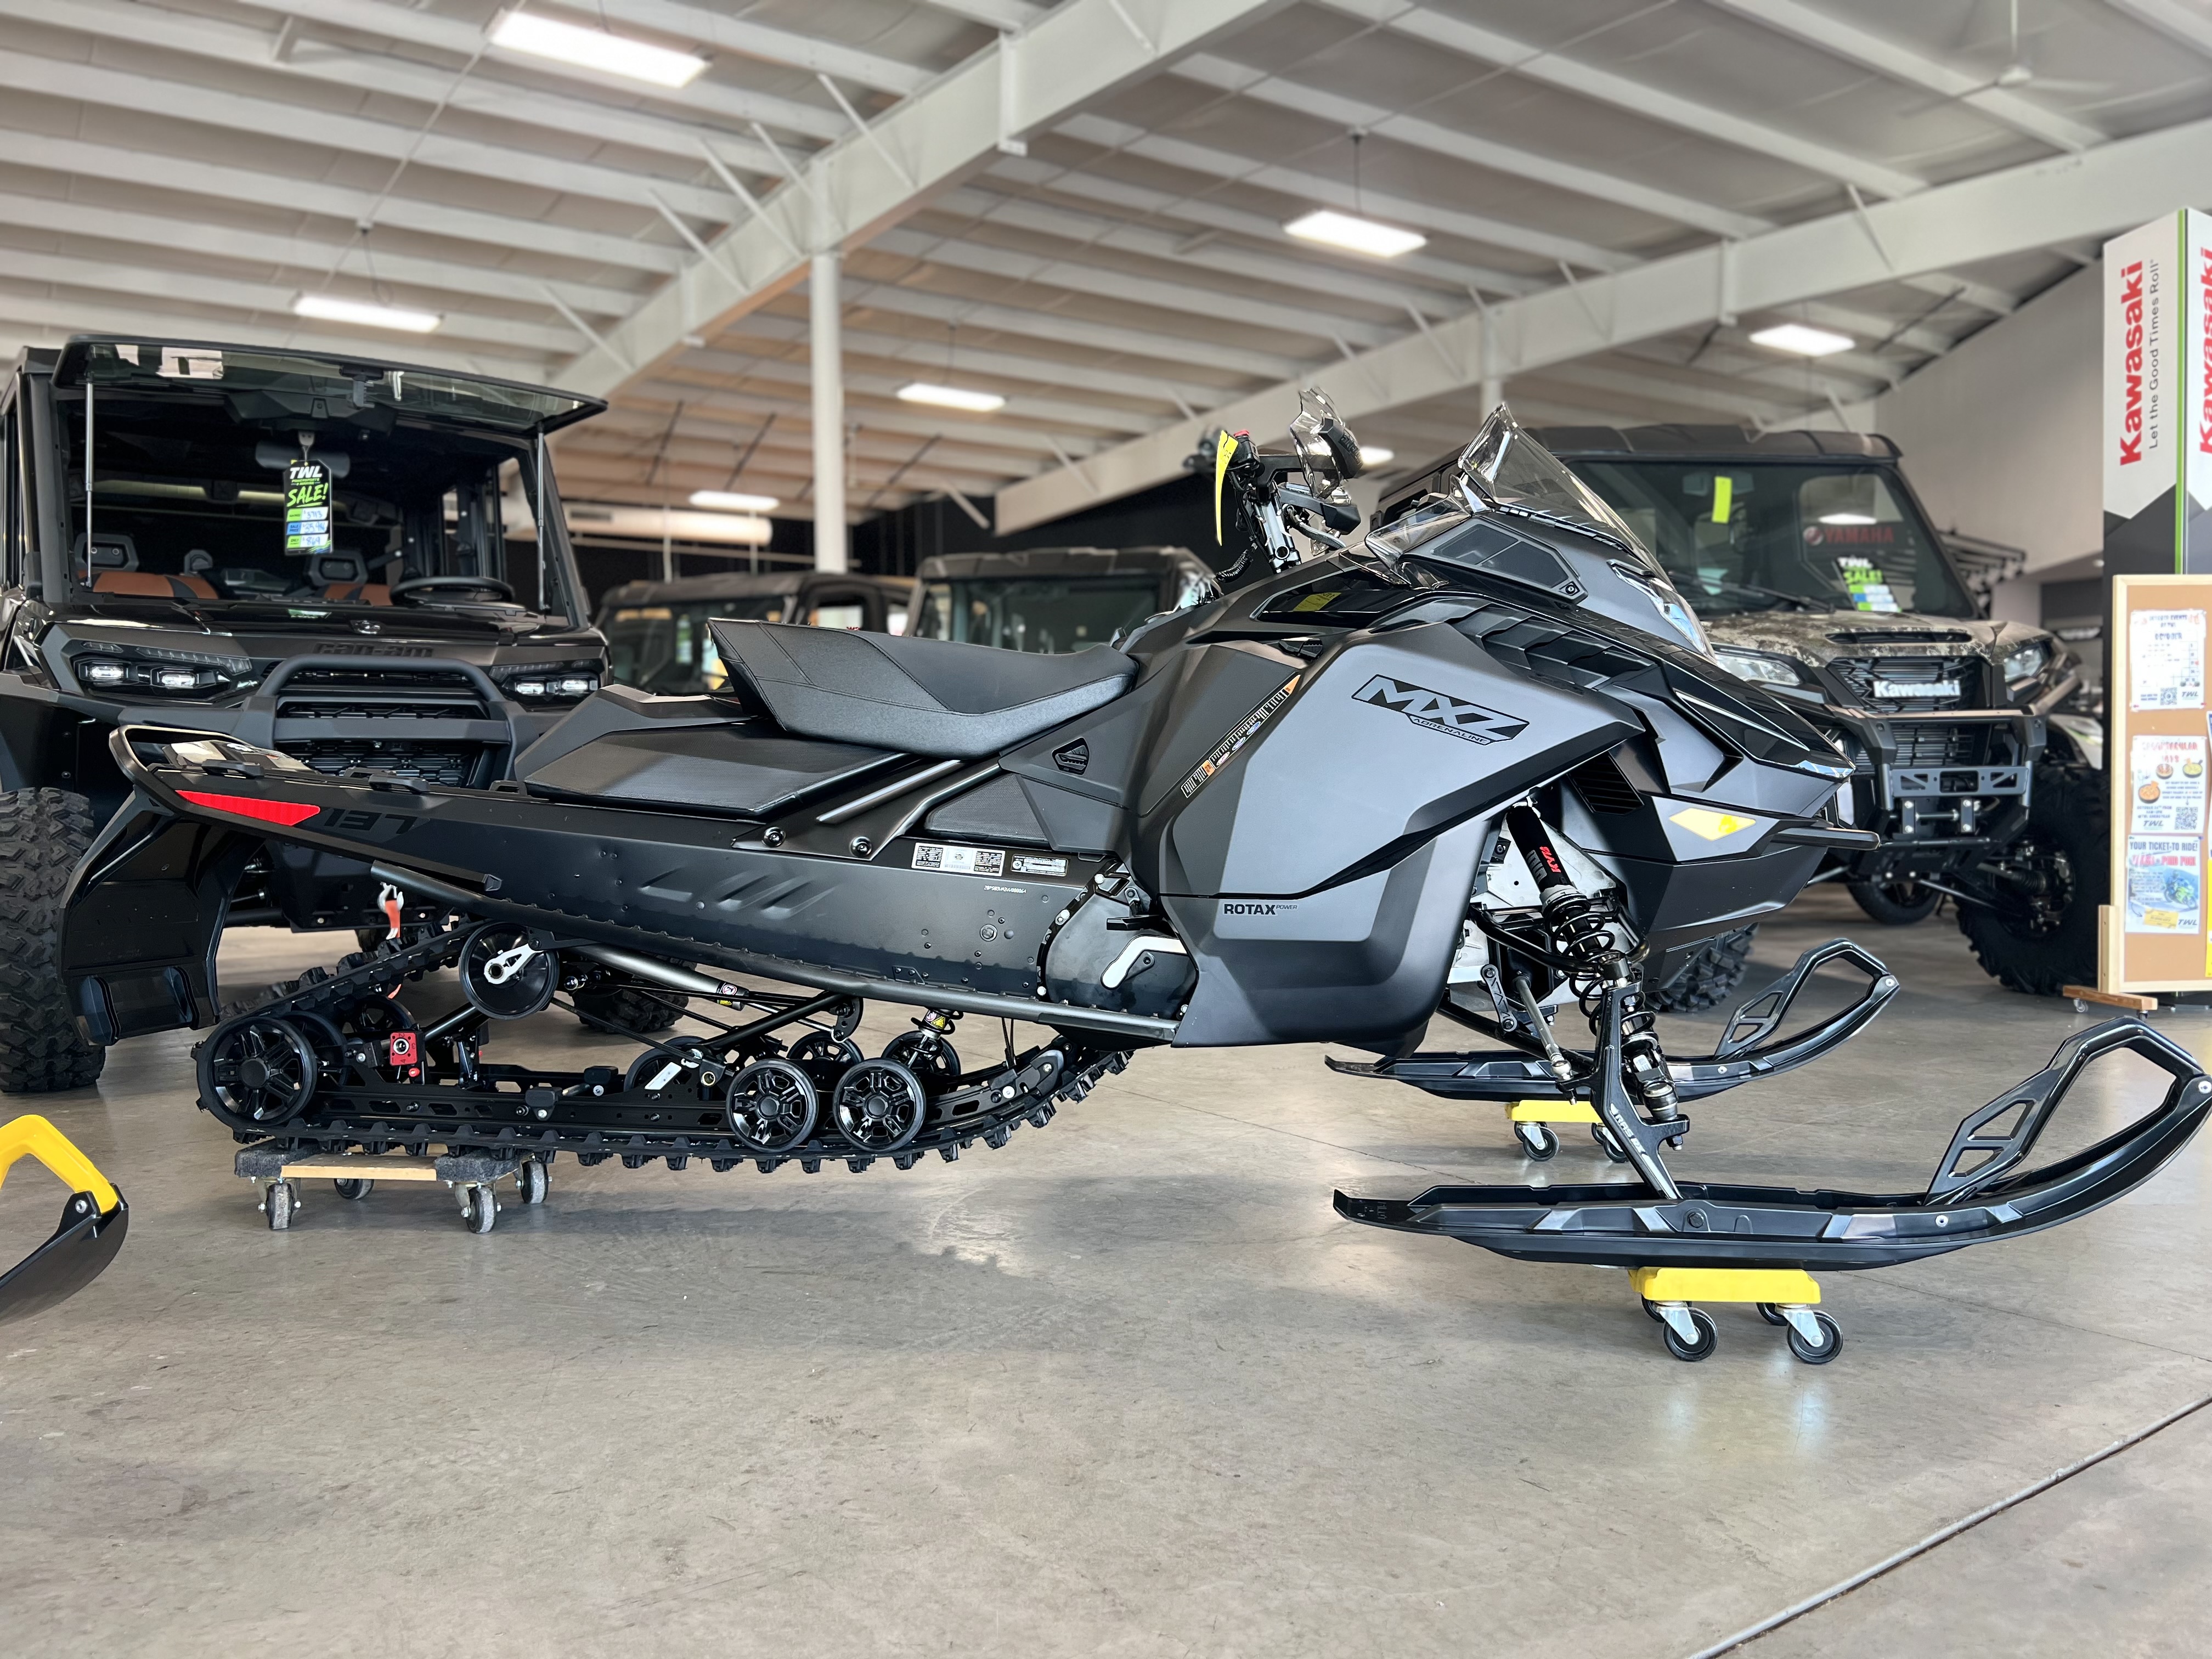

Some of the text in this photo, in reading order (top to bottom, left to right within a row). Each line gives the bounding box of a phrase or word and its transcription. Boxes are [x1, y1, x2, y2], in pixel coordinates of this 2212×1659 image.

[2149, 298, 2159, 346] Times
[2120, 261, 2143, 466] Kawasaki
[2149, 348, 2159, 391] Good
[2149, 395, 2158, 420] the
[2149, 423, 2158, 449] Let
[290, 466, 323, 479] TWL
[286, 483, 329, 507] SALE!
[1825, 527, 1894, 543] YAMAHA
[312, 642, 433, 658] can-am
[1874, 680, 1960, 697] Kawasaki
[1351, 674, 1530, 741] MXZ
[1413, 718, 1491, 744] ADRENALINE
[324, 808, 418, 834] 137
[1539, 846, 1561, 872] KYB
[2130, 842, 2146, 850] YOUR
[2181, 843, 2198, 851] RIDE!
[1224, 904, 1276, 915] ROTAX
